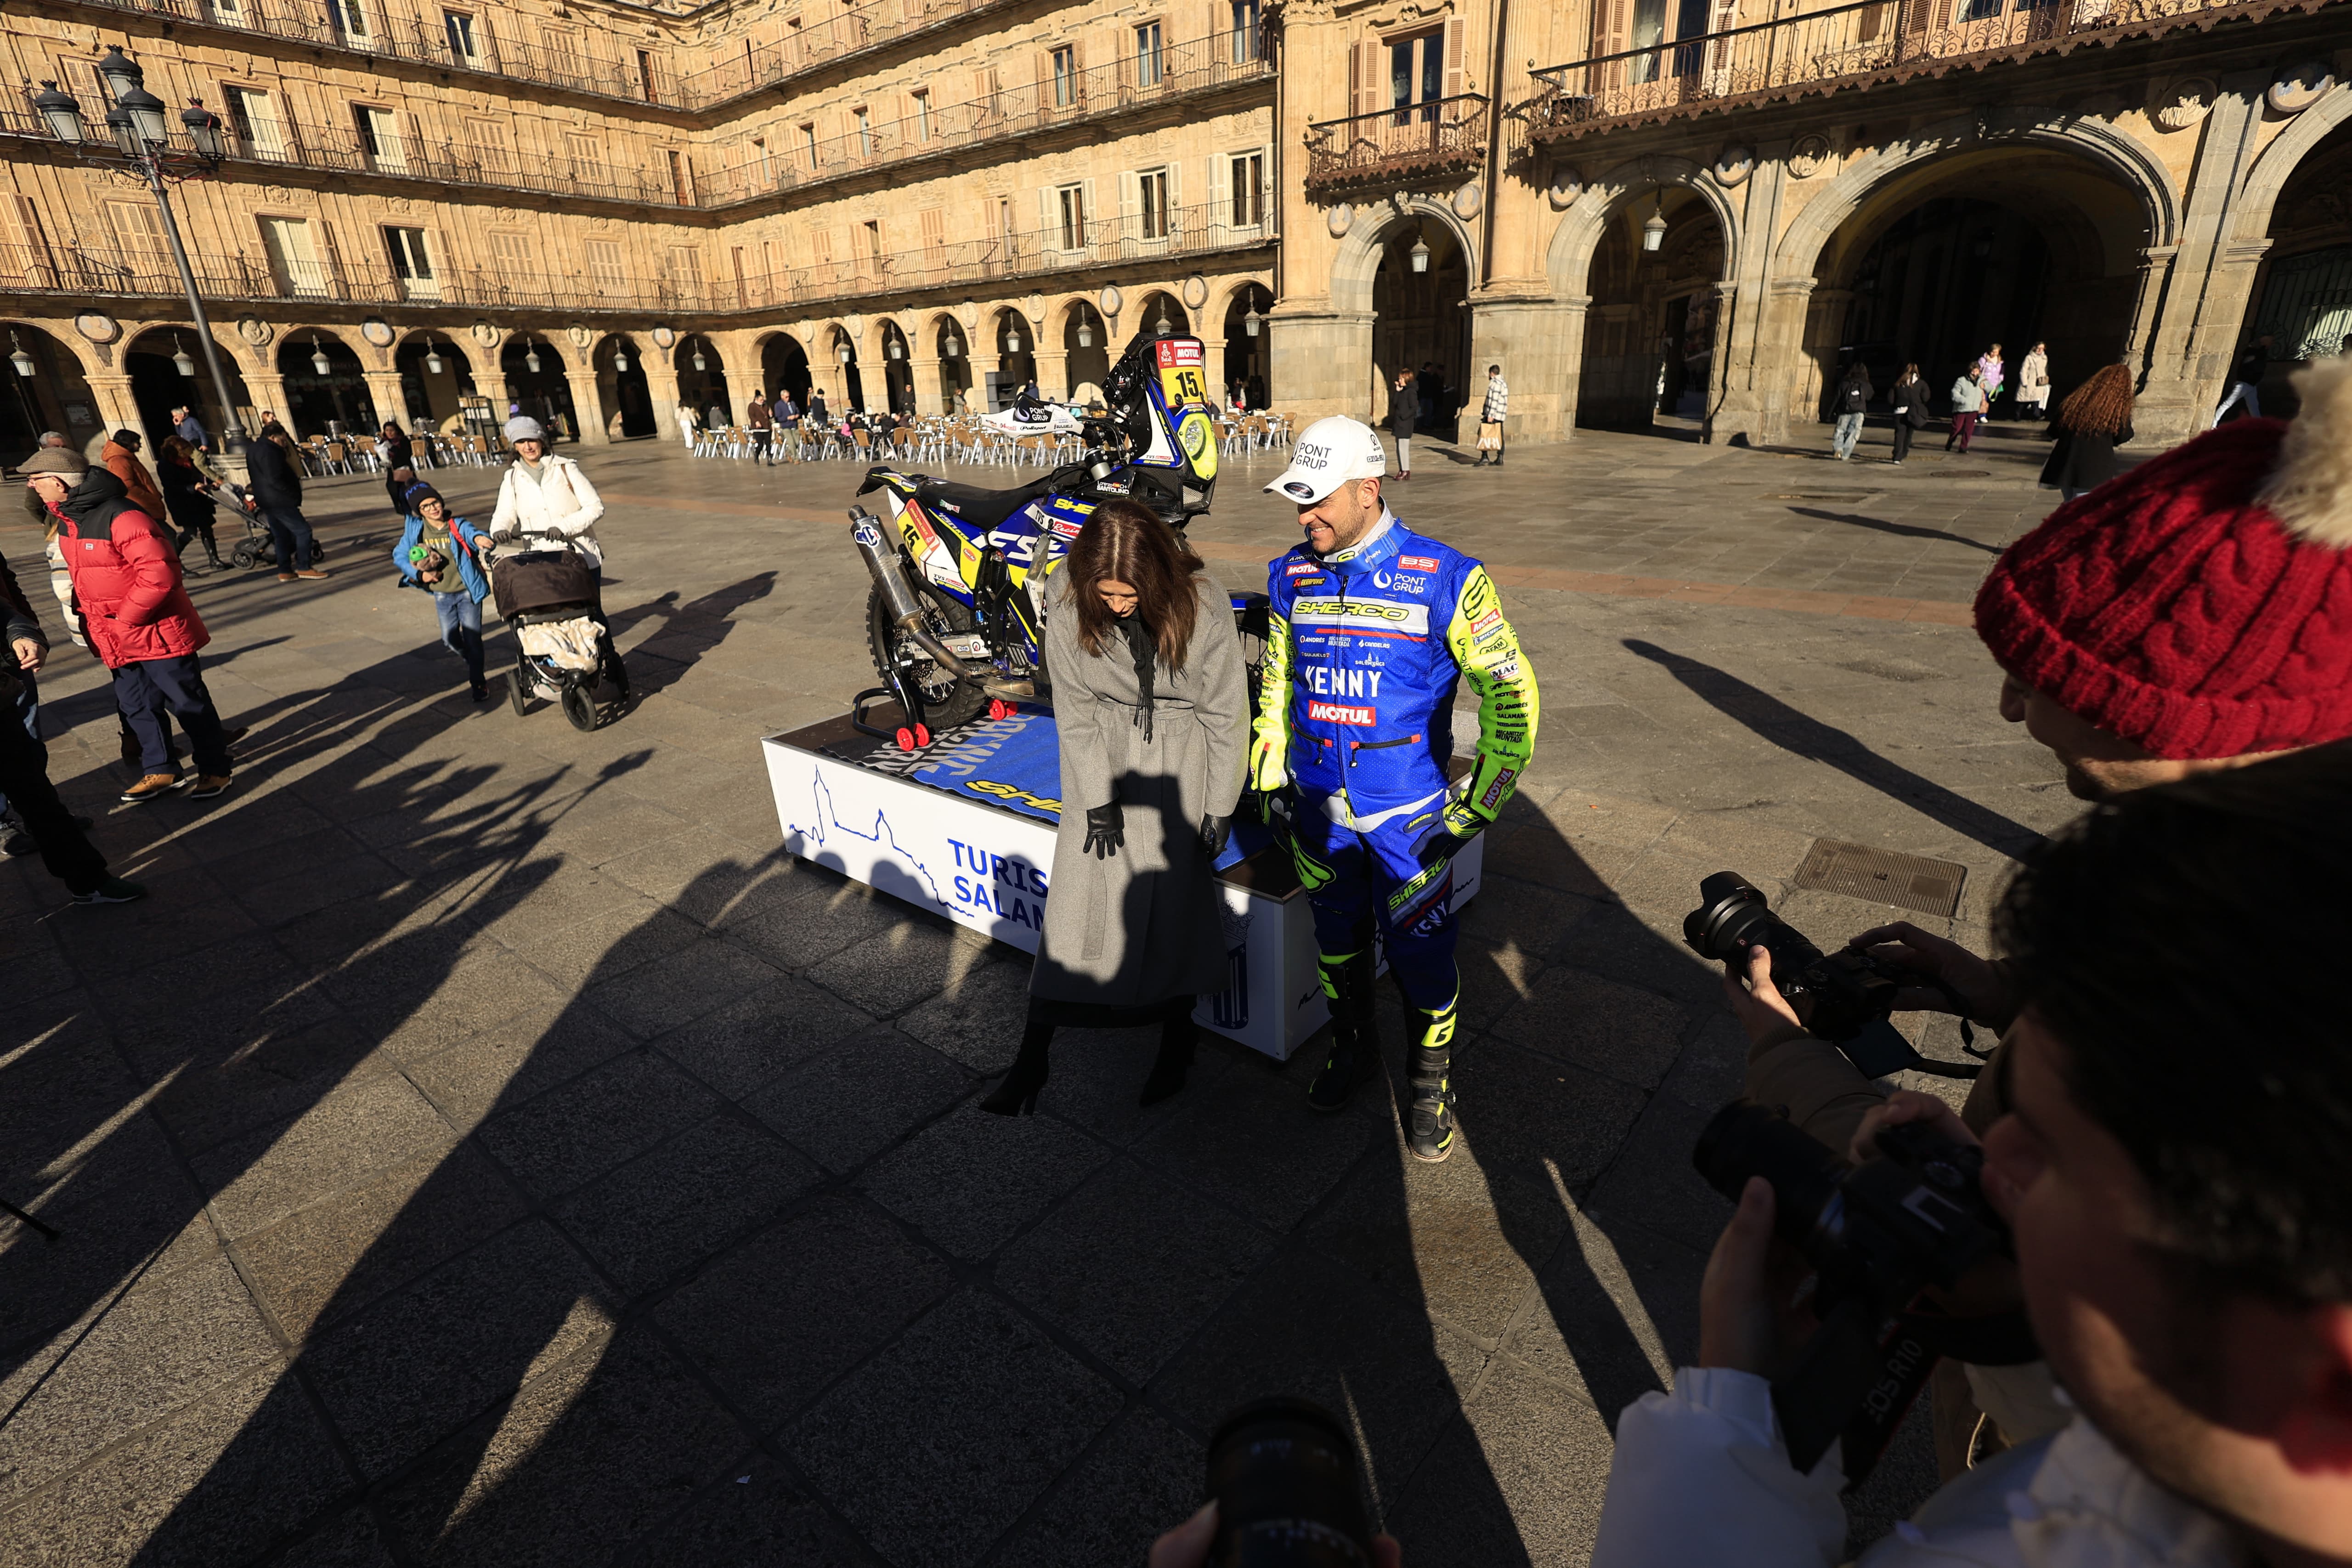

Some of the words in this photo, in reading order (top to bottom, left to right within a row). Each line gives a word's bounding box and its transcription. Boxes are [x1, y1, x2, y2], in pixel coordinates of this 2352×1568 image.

[1177, 349, 1199, 358] MOTUL
[1176, 372, 1199, 397] 15
[1299, 442, 1332, 458] PONT
[1296, 455, 1327, 470] GRUP
[1097, 485, 1129, 494] SANTOLINO
[1035, 510, 1045, 524] TVS
[903, 524, 920, 552] 15
[1289, 552, 1312, 562] AIROH
[1401, 556, 1434, 567] BS
[1287, 563, 1318, 574] MOTUL
[1394, 573, 1426, 586] PONT
[1393, 582, 1424, 594] GRUP
[1295, 602, 1409, 621] SHERCO
[1473, 611, 1498, 633] MOTUL
[1479, 624, 1504, 640] MICHELIN
[1485, 641, 1504, 653] AFAM
[1461, 648, 1472, 671] PONT
[1469, 673, 1484, 692] GRUP
[1491, 663, 1518, 677] MAC
[1305, 666, 1382, 697] KENNY
[1311, 704, 1372, 724] MOTUL
[1495, 734, 1522, 743] MUNTADA
[1483, 770, 1512, 808] MOTUL
[948, 838, 1048, 899] TURIS
[1886, 1337, 1923, 1380] R10
